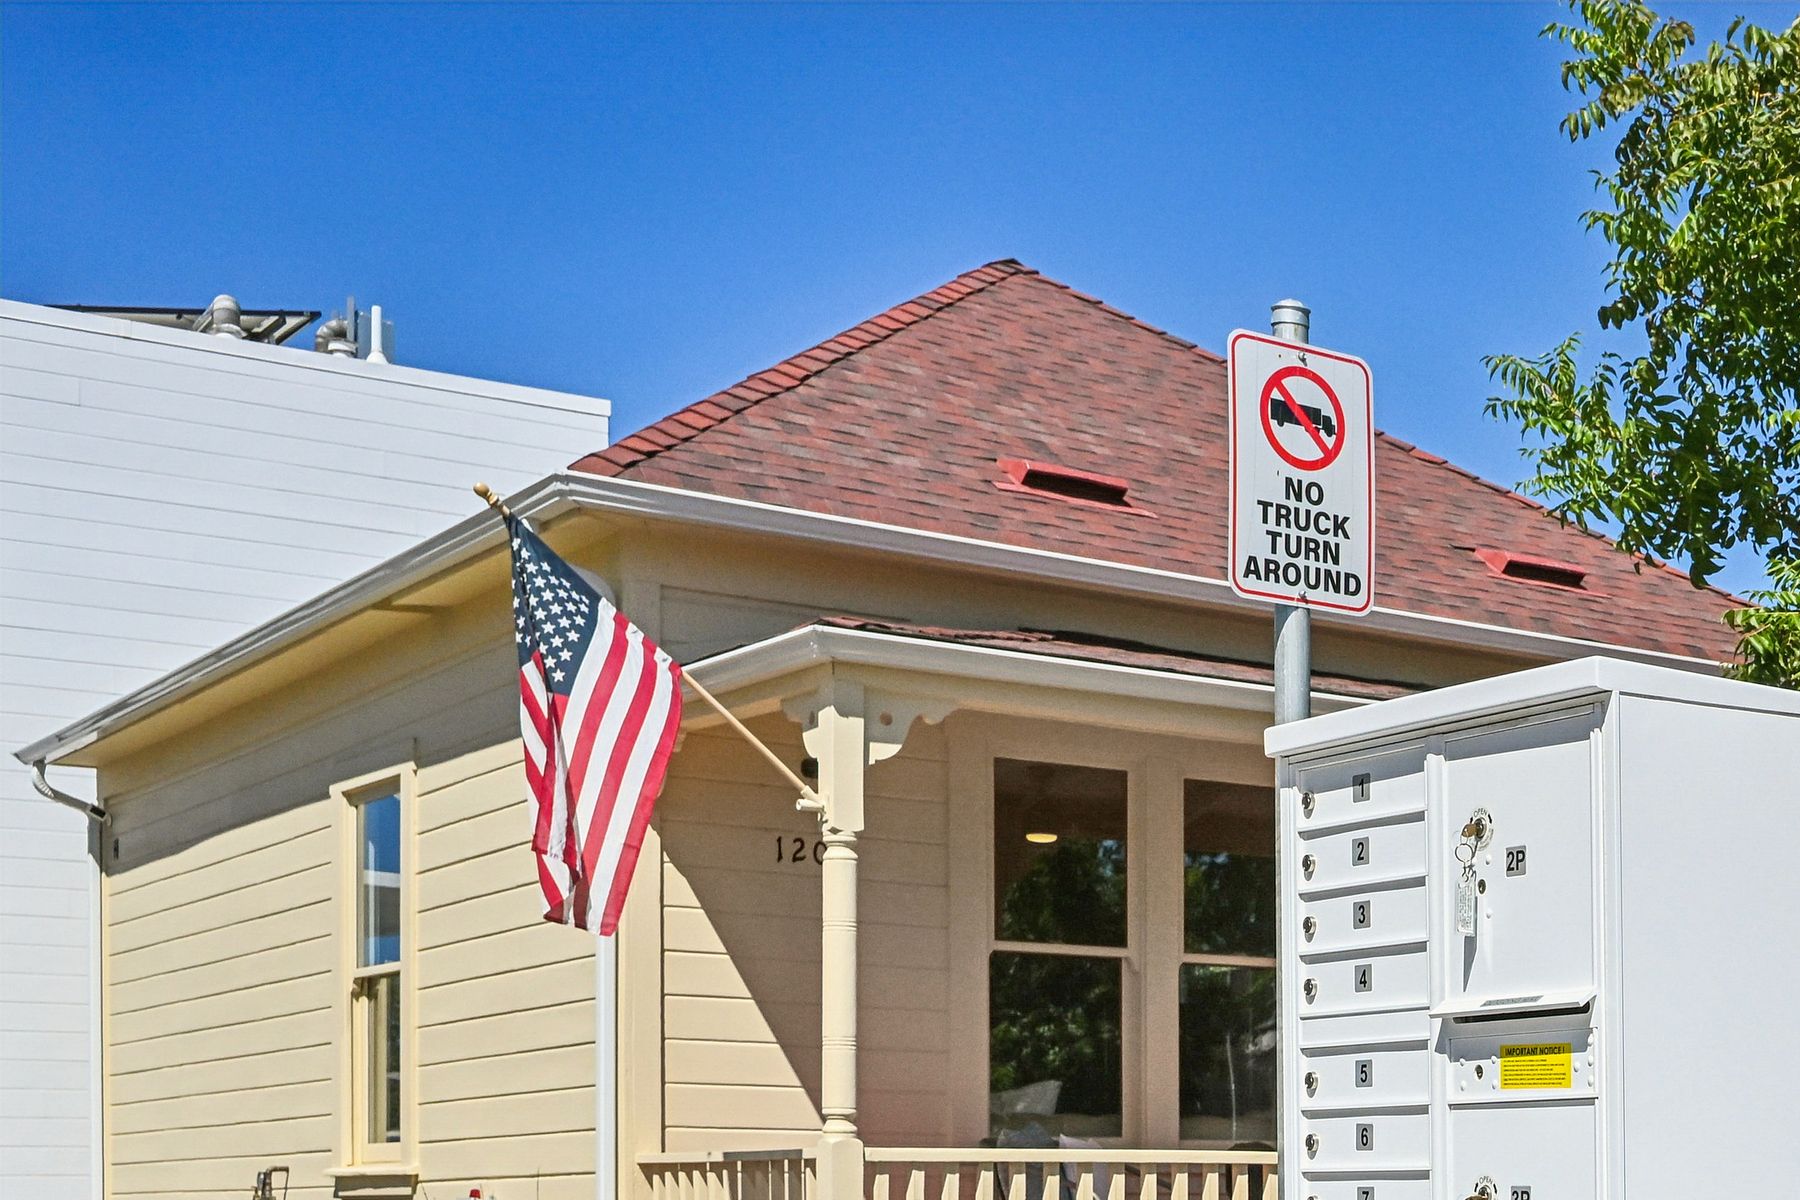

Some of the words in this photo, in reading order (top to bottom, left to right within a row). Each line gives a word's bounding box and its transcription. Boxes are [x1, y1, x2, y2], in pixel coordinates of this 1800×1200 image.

[1284, 476, 1324, 506] NO
[1257, 499, 1350, 540] TRUCK
[1265, 529, 1340, 566] TURN
[1242, 555, 1361, 597] AROUND
[1359, 778, 1365, 798] 1
[1356, 841, 1365, 861] 2
[1506, 850, 1526, 872] 2P
[1358, 904, 1366, 924] 3
[1359, 968, 1368, 988] 4
[1504, 1047, 1538, 1057] IMPORTANT
[1360, 1063, 1368, 1083] 5
[1361, 1127, 1369, 1147] 6
